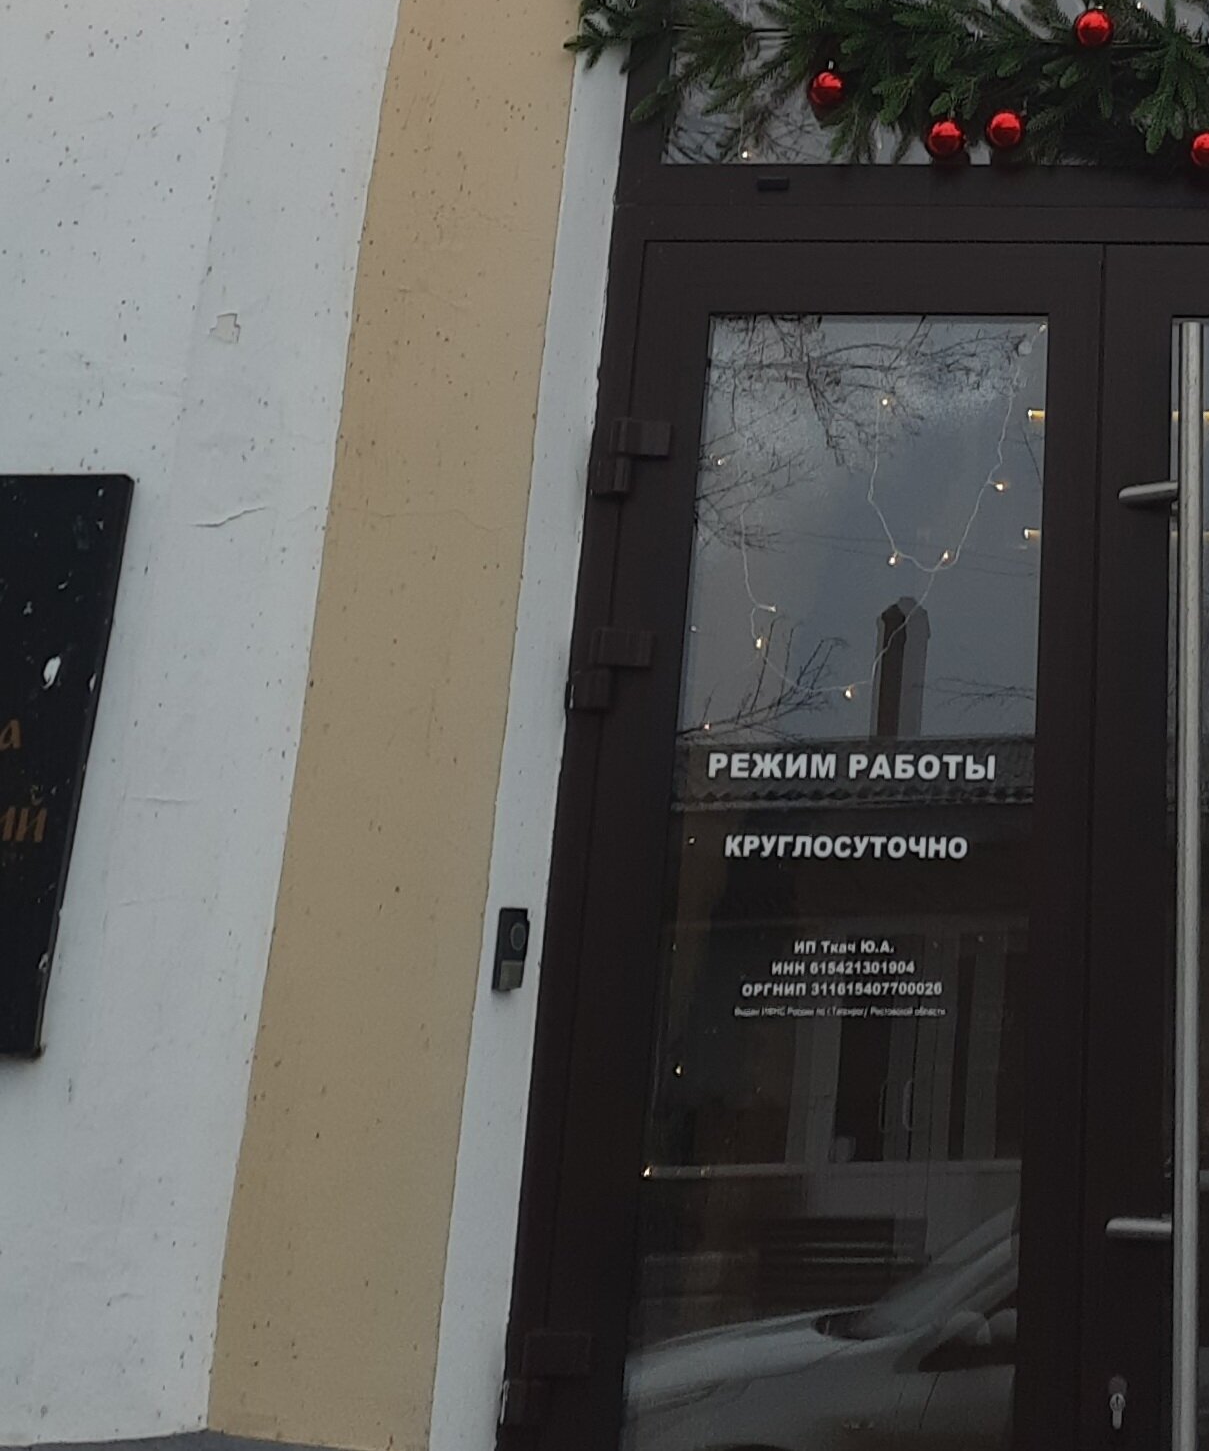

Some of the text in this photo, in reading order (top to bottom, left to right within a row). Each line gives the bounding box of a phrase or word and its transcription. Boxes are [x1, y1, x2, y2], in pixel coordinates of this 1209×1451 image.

[707, 753, 997, 781] РЕЖИМ РАБОТЫ
[724, 835, 968, 860] КРУГЛОСУТОЧНО
[794, 940, 816, 954] ИП
[820, 940, 856, 954] Ткач
[771, 960, 915, 975] ИНН 615421301904
